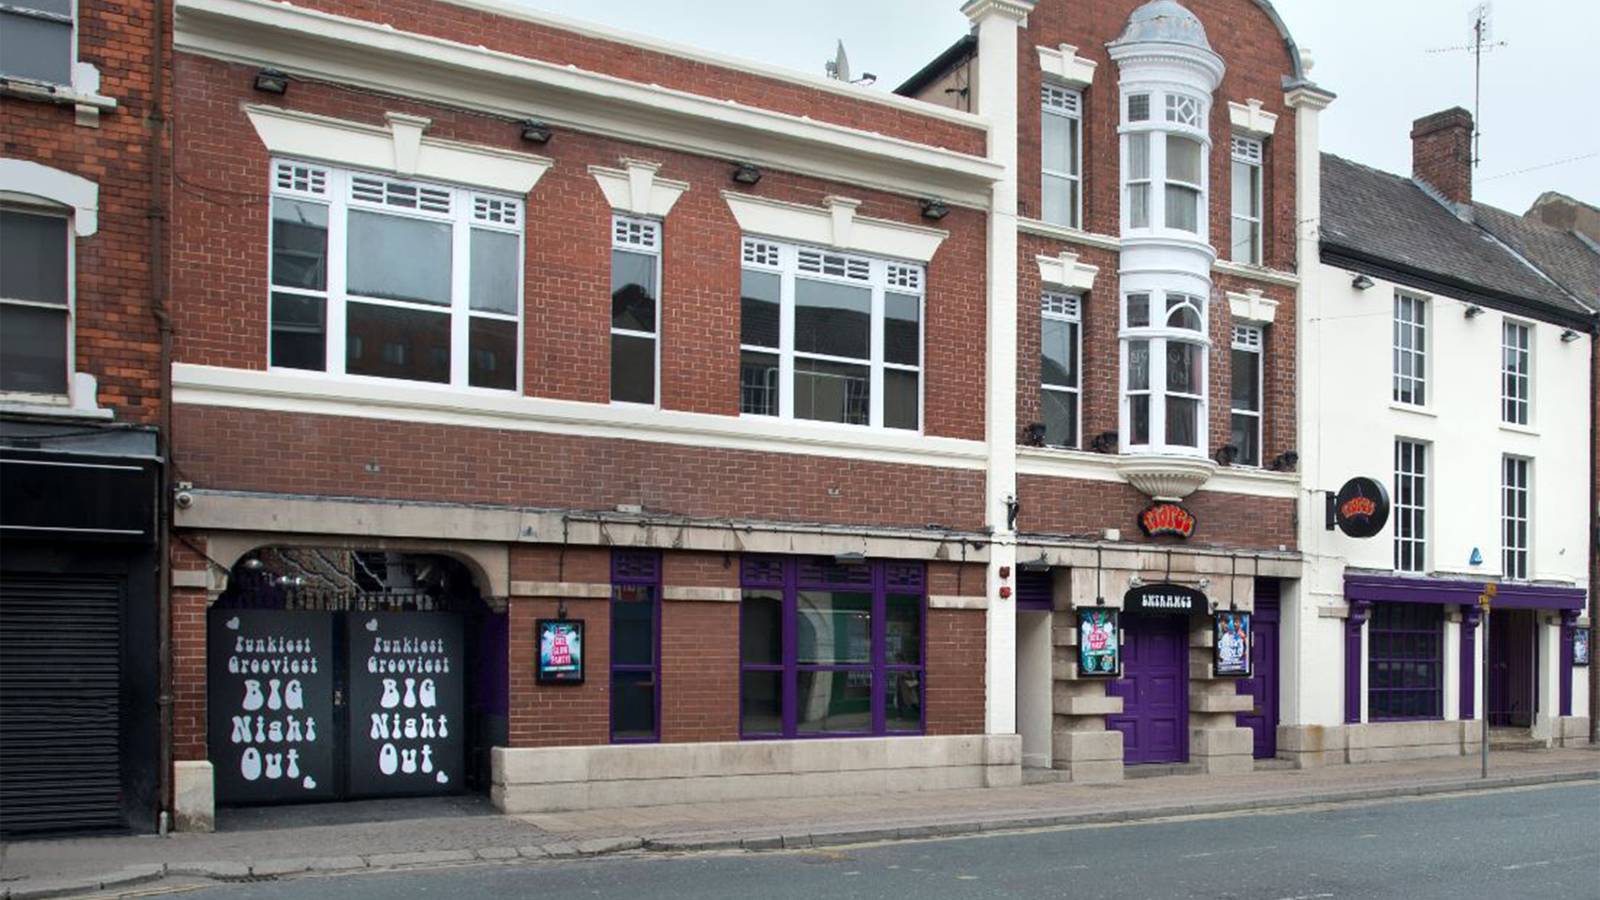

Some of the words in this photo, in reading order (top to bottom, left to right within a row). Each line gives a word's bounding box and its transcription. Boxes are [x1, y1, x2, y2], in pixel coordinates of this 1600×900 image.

[1142, 594, 1192, 608] ENTRANCE
[234, 635, 312, 653] Funkiest
[373, 636, 445, 653] Funkiest
[228, 655, 318, 673] Grooviest
[367, 656, 450, 673] Grooviest
[242, 679, 304, 711] BIG
[380, 678, 436, 709] BIG
[231, 715, 317, 744] Night
[370, 713, 449, 740] Night
[240, 747, 300, 781] Out
[379, 743, 433, 775] Out
